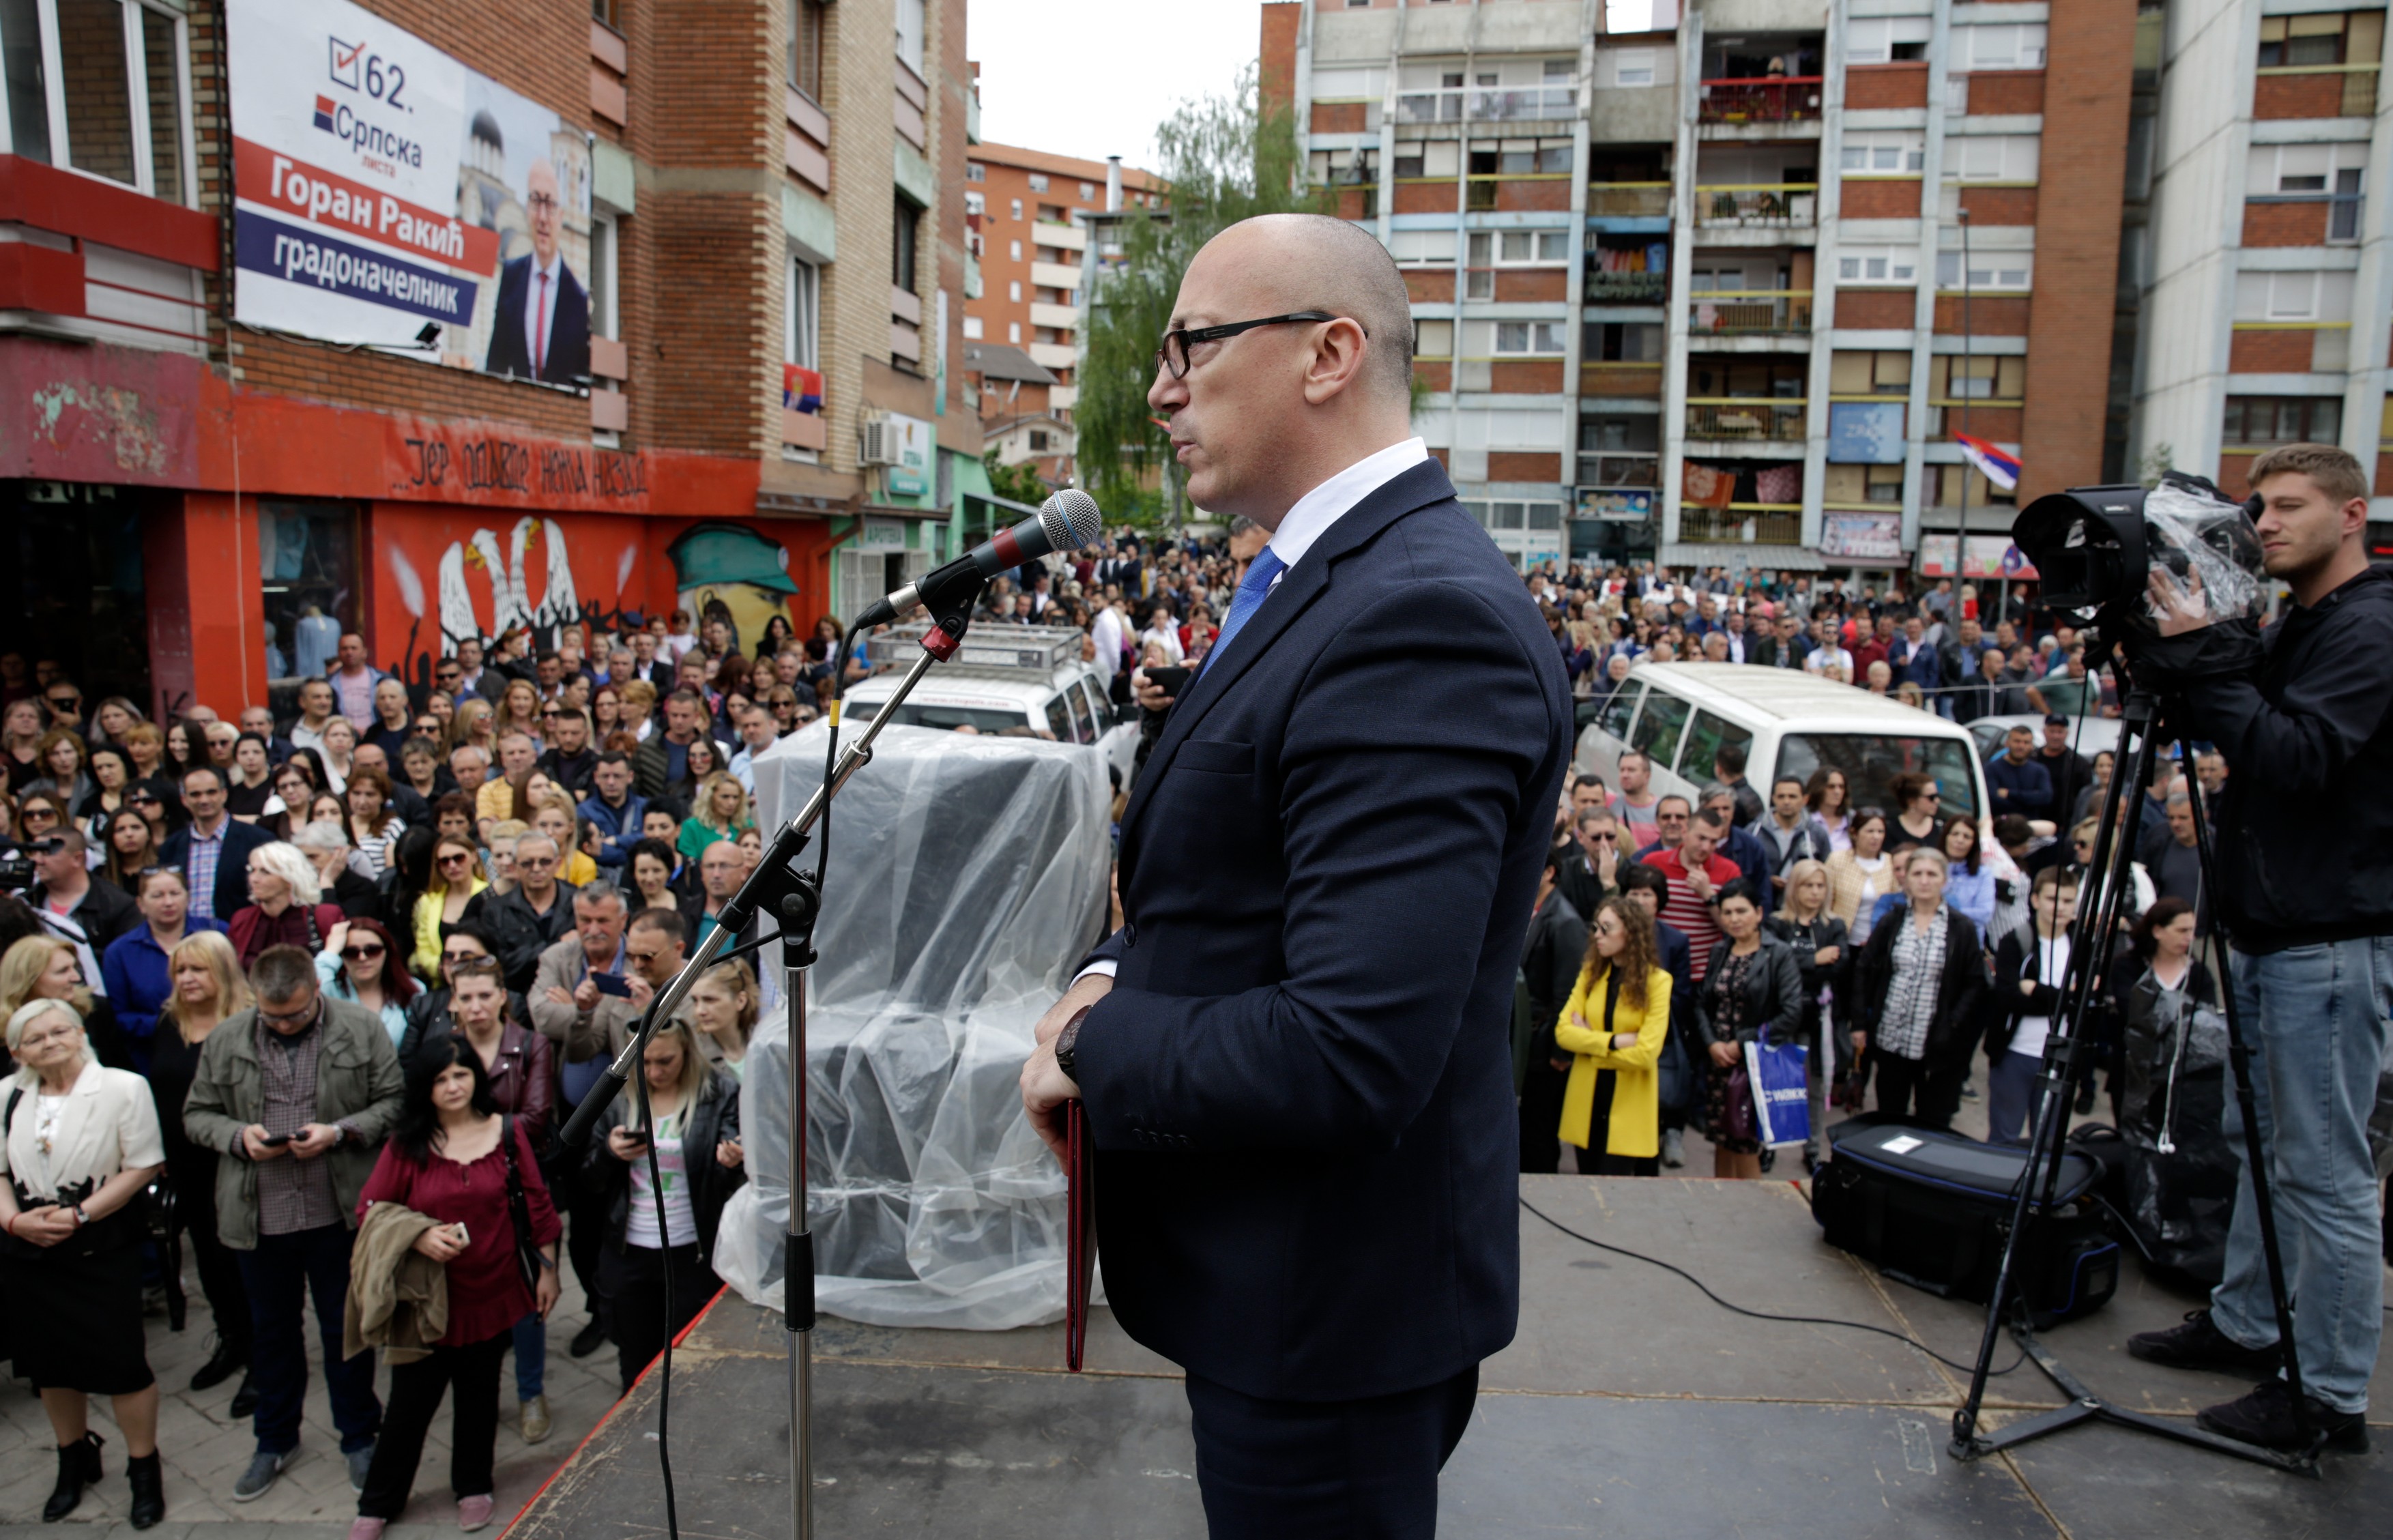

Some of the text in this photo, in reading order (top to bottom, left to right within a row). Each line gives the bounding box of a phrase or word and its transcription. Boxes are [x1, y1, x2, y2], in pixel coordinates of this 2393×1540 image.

[365, 54, 414, 114] 62.
[334, 104, 423, 169] Српска
[361, 154, 396, 178] листа
[270, 156, 465, 259] Горан Ракић
[274, 233, 459, 314] градоначелник
[950, 560, 974, 574] SHURE
